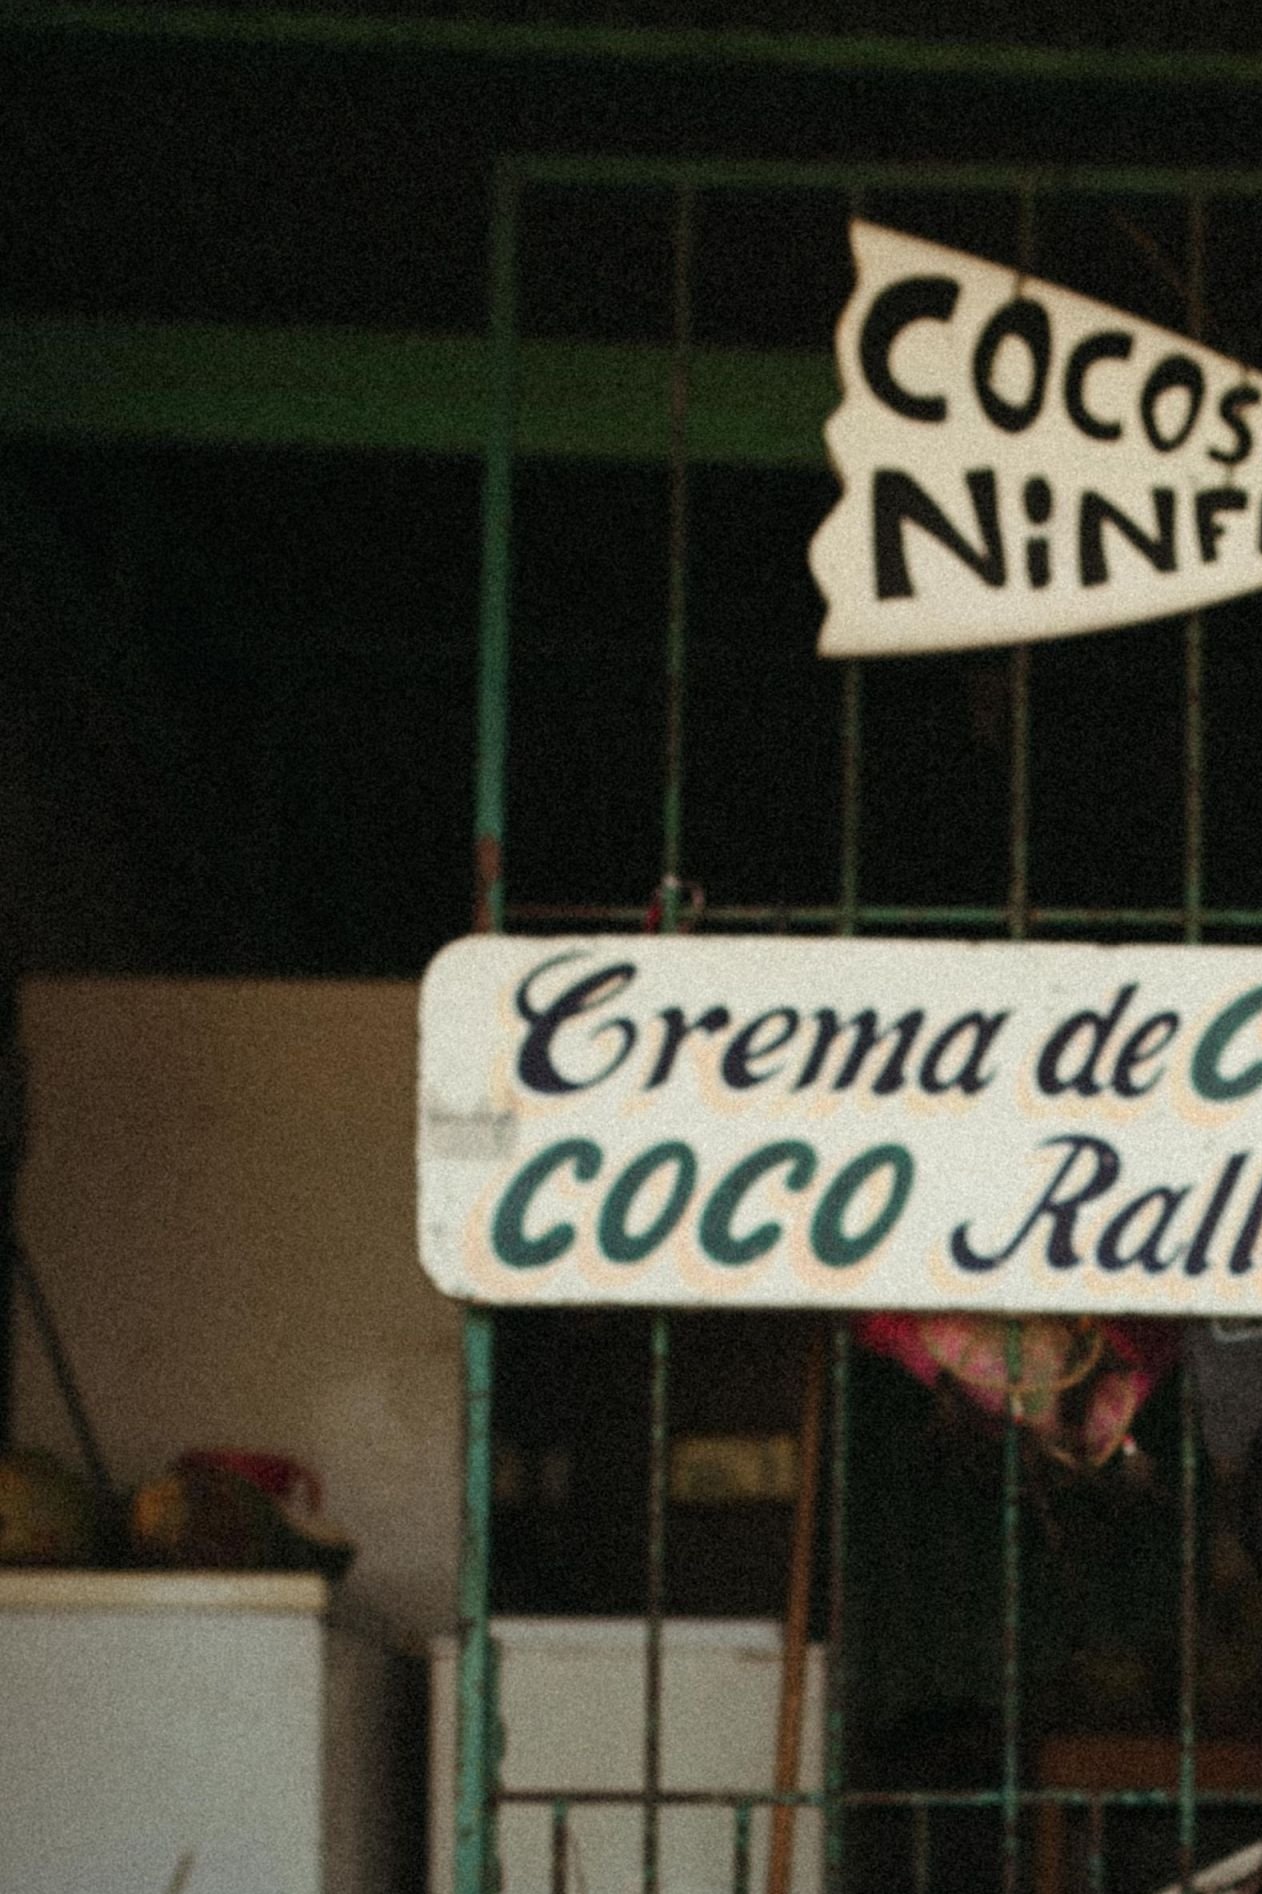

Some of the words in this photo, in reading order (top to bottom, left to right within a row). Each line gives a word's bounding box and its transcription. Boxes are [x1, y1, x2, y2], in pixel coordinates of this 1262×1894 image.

[859, 274, 1262, 465] COCOS
[514, 949, 1010, 1095] Crema
[1036, 982, 1181, 1099] de
